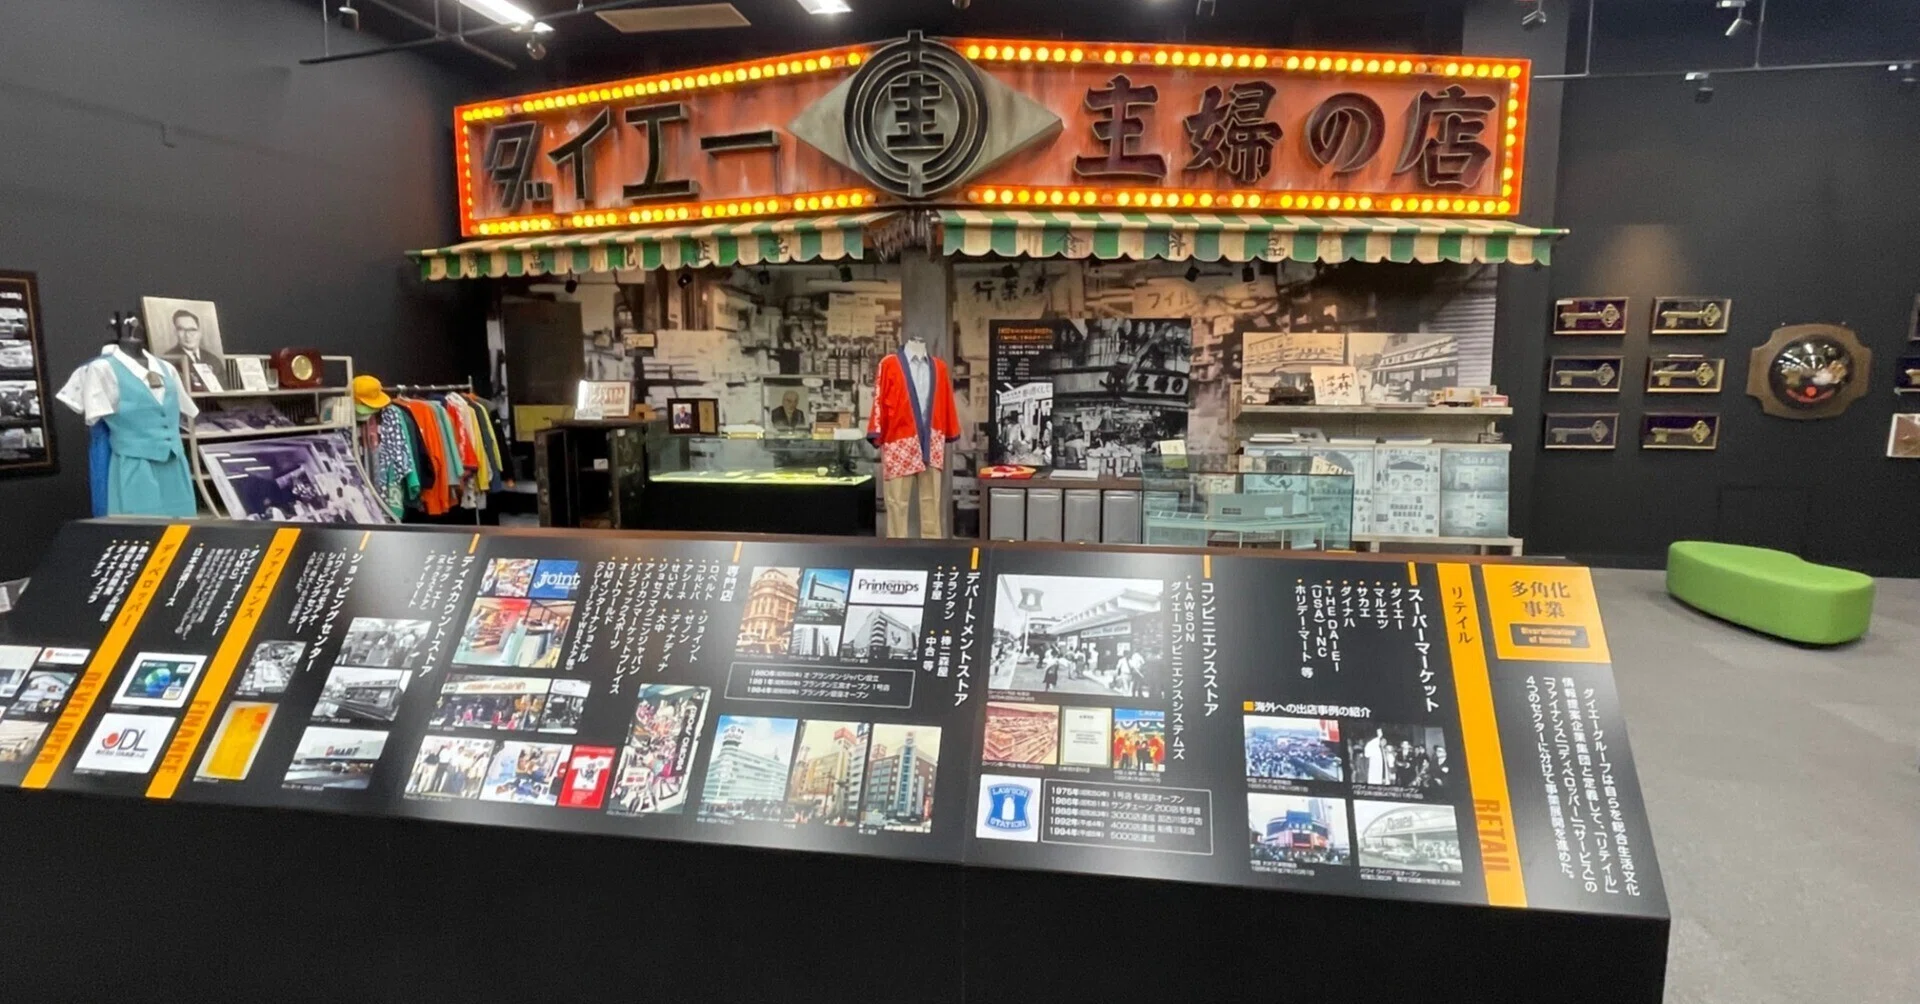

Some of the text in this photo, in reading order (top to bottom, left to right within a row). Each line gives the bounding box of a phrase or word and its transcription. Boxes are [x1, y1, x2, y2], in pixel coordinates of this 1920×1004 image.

[1073, 74, 1498, 188] 主婦の店
[483, 103, 781, 213] ダイエー
[122, 543, 176, 627] ディベロッパー
[243, 548, 285, 619] ファイナンス
[677, 564, 694, 600] アシーネ
[720, 565, 740, 602] 専門店
[857, 578, 920, 594] Printemps
[931, 571, 945, 601] 十字屋
[944, 571, 959, 620] プランタン
[1357, 587, 1371, 617] サカエ
[1511, 580, 1571, 598] 多角化
[305, 553, 364, 672] ショッピングセンター
[419, 555, 476, 678] ディスカウントストア
[654, 613, 668, 632] 大中
[1184, 581, 1196, 643] LAWSON
[1340, 586, 1355, 628] ダイナハ
[1373, 587, 1388, 629] マルエツ
[1390, 587, 1405, 630] ダイエー
[1451, 587, 1473, 644] リテイル
[1523, 600, 1565, 617] 事業
[690, 614, 708, 663] ジョイント
[954, 571, 981, 707] デパートメントストア
[1201, 582, 1219, 717] コンビニエンスストア
[1408, 588, 1439, 712] スーパーマーケット
[1171, 581, 1185, 760] ダイエーコンビニエンスシステムズ
[1254, 701, 1372, 719] 海外への出店事例の紹介
